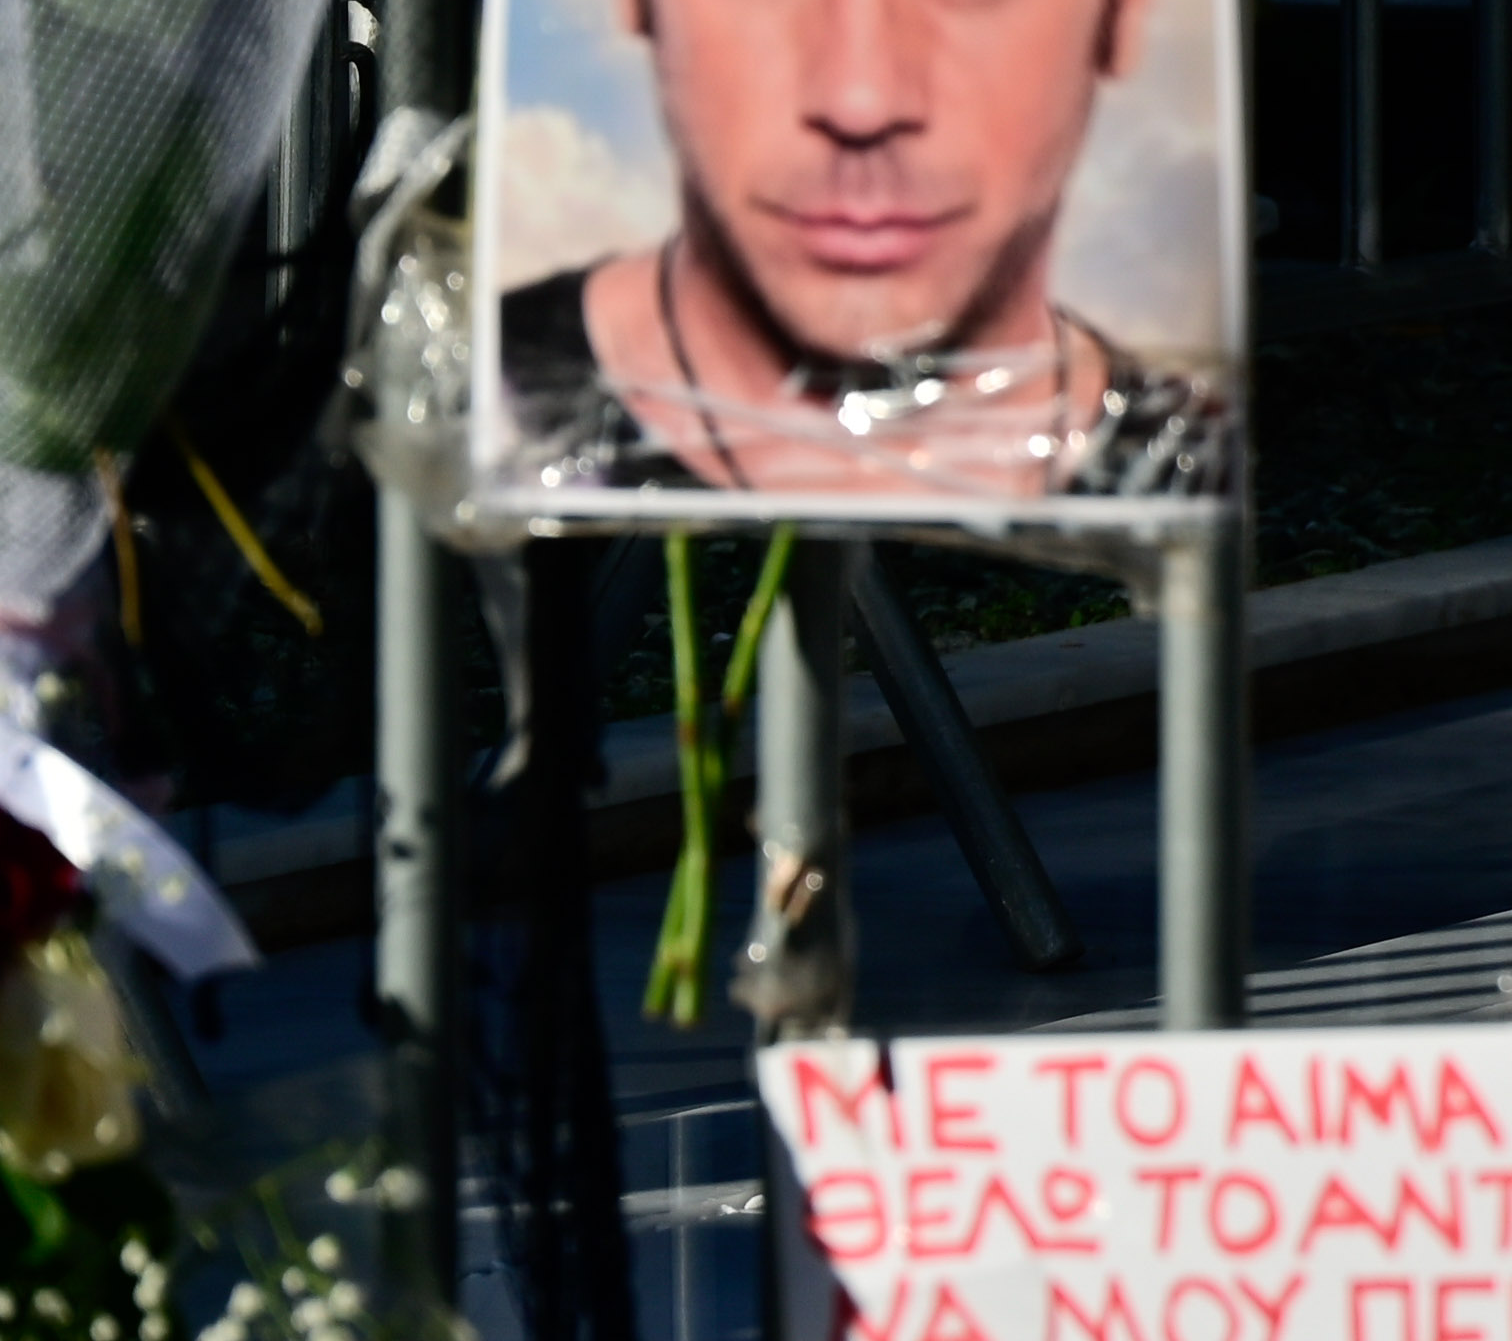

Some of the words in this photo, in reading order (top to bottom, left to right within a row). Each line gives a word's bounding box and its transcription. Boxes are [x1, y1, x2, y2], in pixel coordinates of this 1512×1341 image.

[785, 1049, 1006, 1154] ΜΕ
[1034, 1054, 1189, 1151] ΤΟ
[1222, 1054, 1502, 1153] ΑΙΜΑ
[804, 1161, 1100, 1260] ΘΕΛΩ
[1135, 1166, 1281, 1255] ΤΟ
[1046, 1275, 1302, 1341] ΜΟΥ
